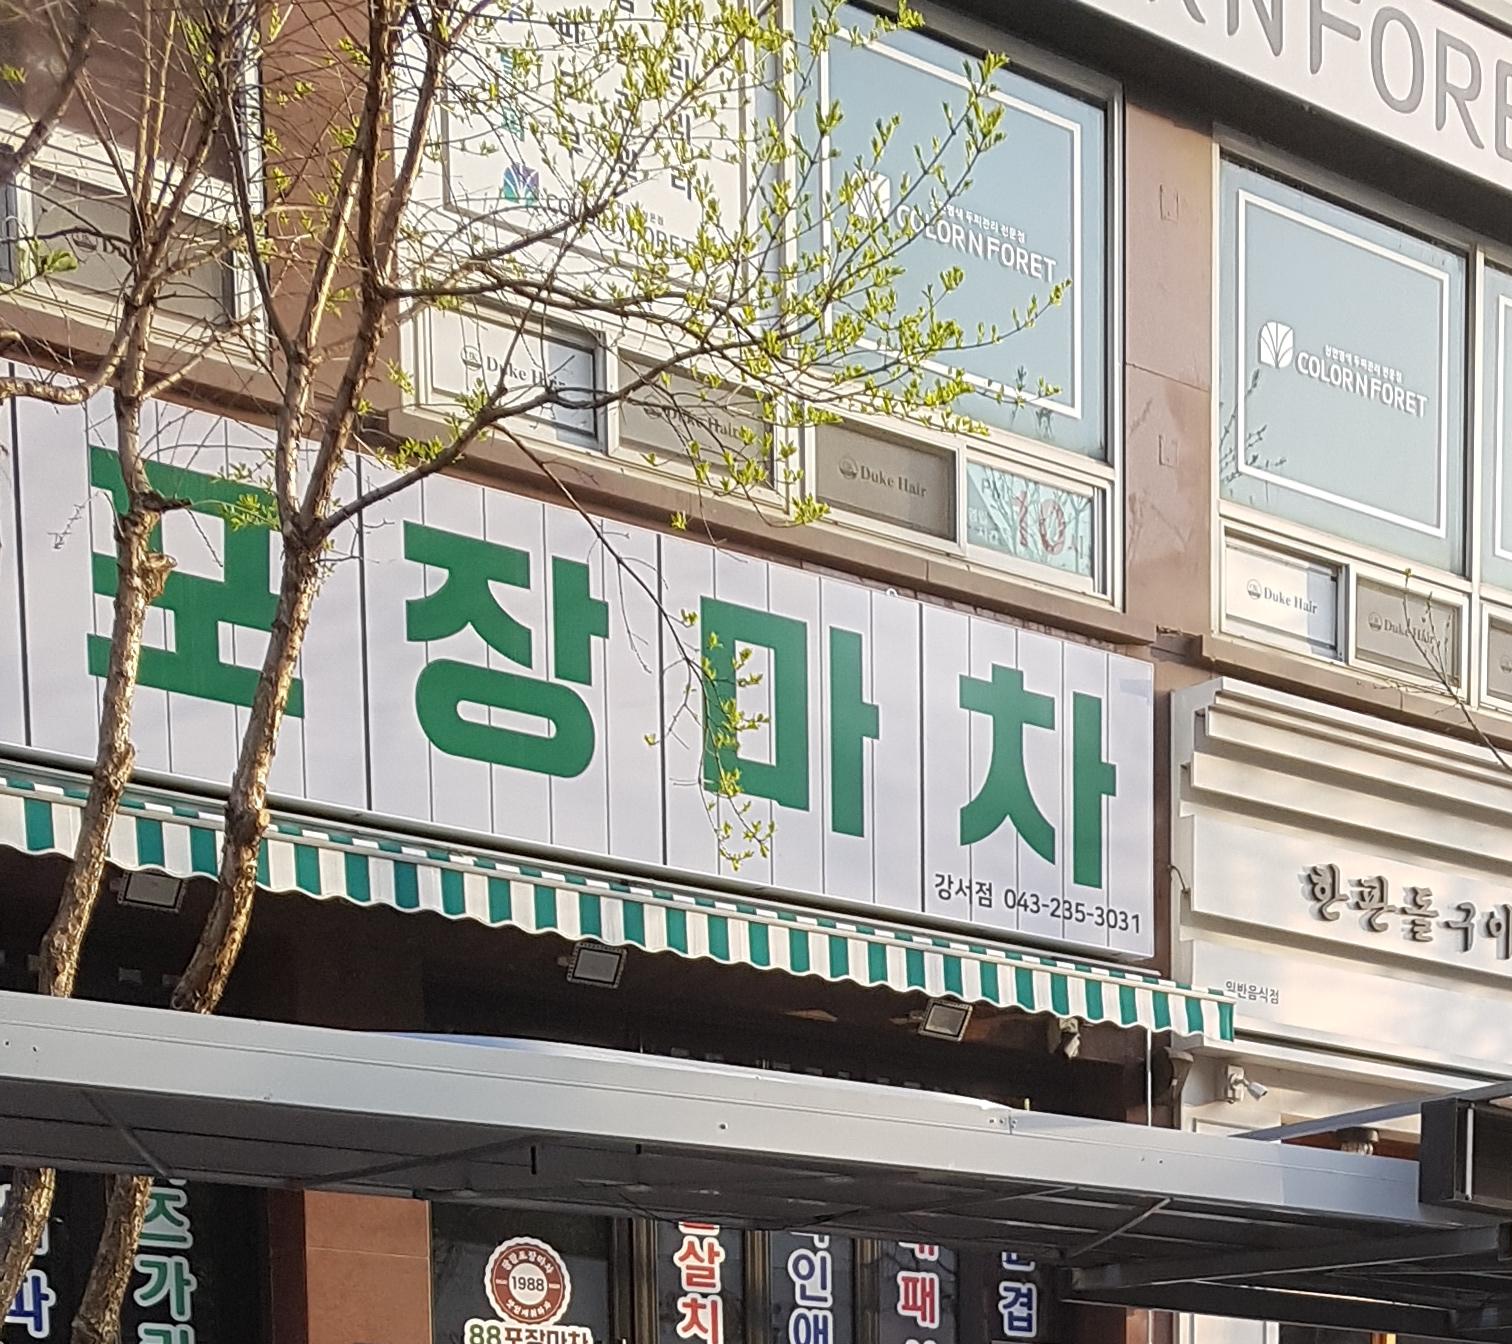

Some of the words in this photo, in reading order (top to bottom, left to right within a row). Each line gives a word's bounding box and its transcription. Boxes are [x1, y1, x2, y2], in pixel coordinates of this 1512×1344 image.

[860, 465, 895, 488] Duke
[898, 475, 928, 498] Hair
[1264, 586, 1292, 607] Duke
[1294, 595, 1318, 614] Hair
[88, 446, 1116, 889] 포장마차
[934, 873, 993, 907] 강서점
[1003, 889, 1141, 934] 043-235-3031
[511, 1275, 545, 1292] 1988
